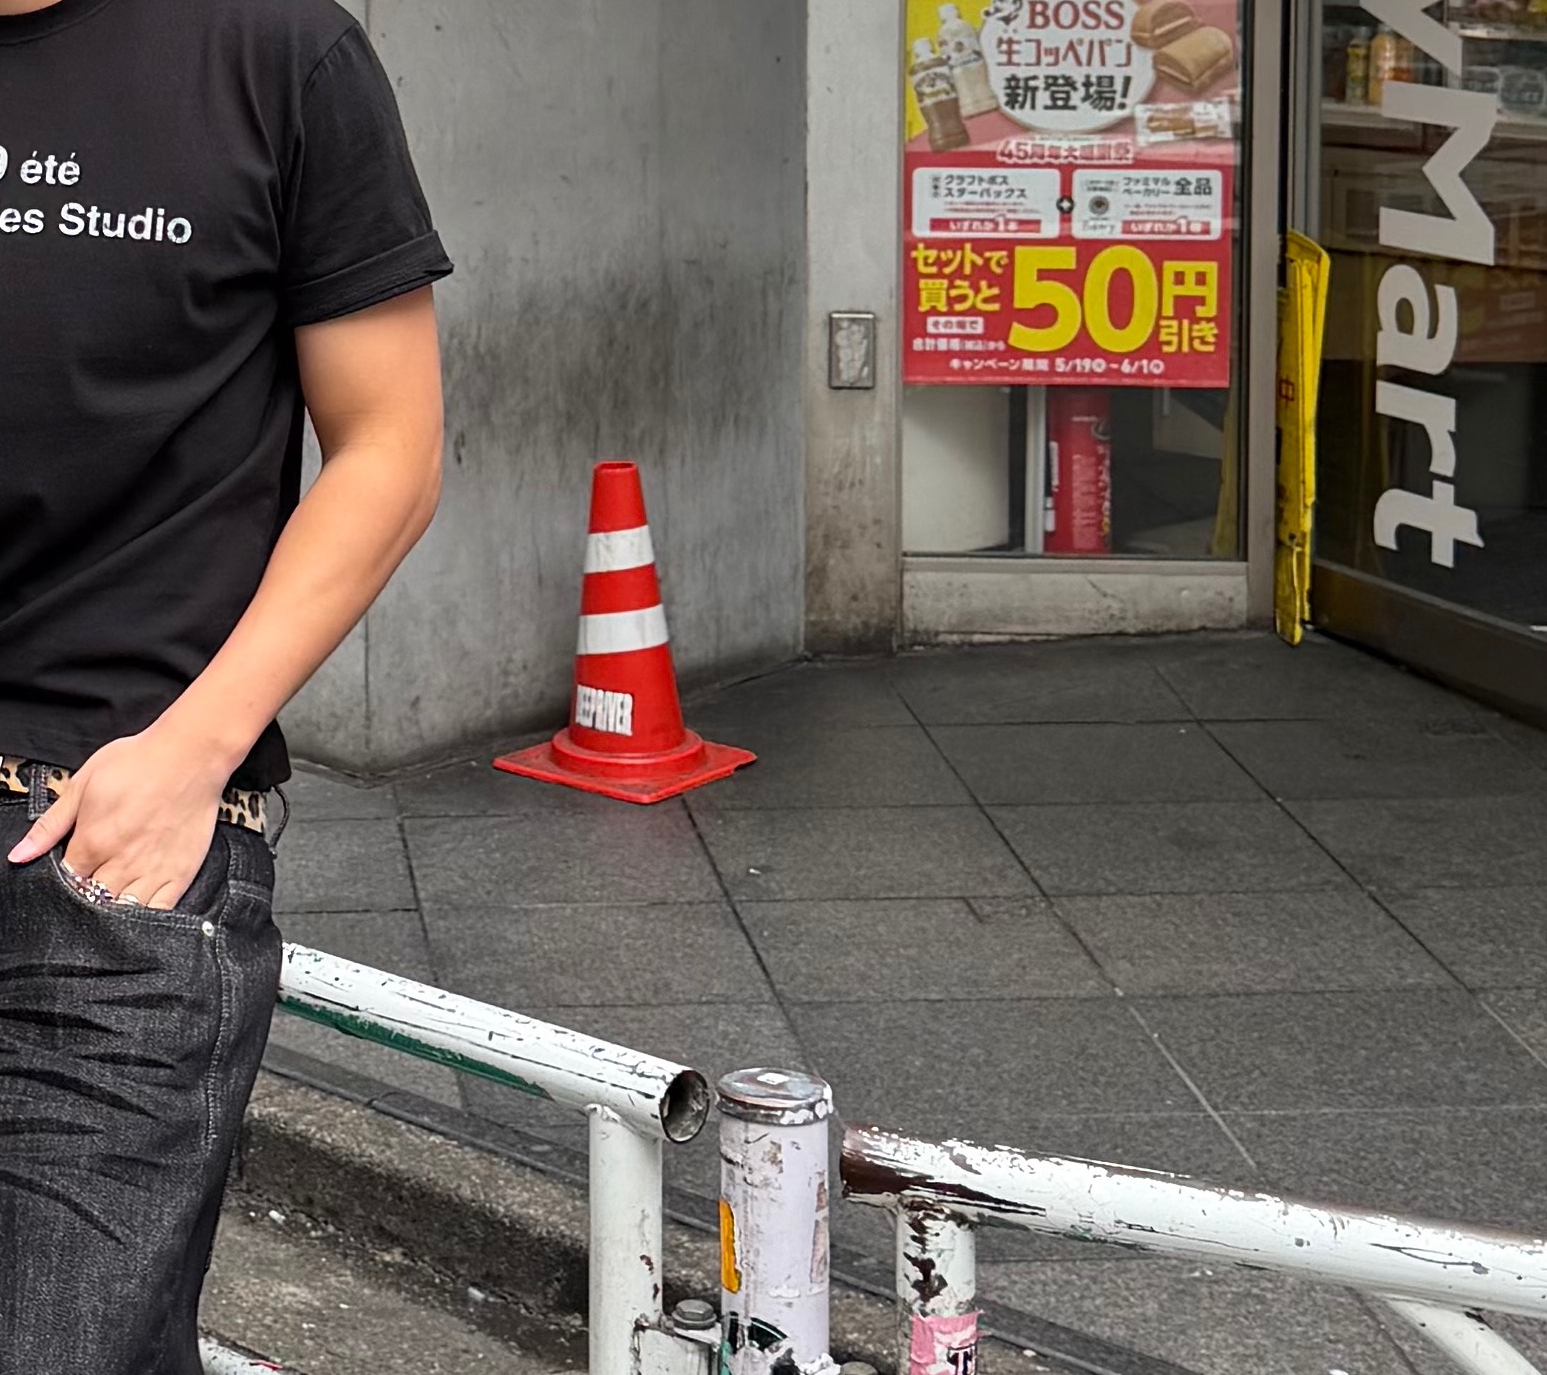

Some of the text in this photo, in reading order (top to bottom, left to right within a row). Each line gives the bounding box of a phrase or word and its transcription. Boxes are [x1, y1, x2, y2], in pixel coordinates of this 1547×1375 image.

[1026, 0, 1125, 30] BOSS
[996, 37, 1133, 67] 生コッペパン
[20, 150, 82, 186] été
[1173, 177, 1213, 196] 全品
[58, 201, 193, 245] Studio
[911, 242, 1009, 275] セットで
[917, 277, 1002, 313] 買うと
[1008, 244, 1159, 353] 50
[1161, 260, 1219, 318] 円
[1158, 318, 1219, 353] 引き
